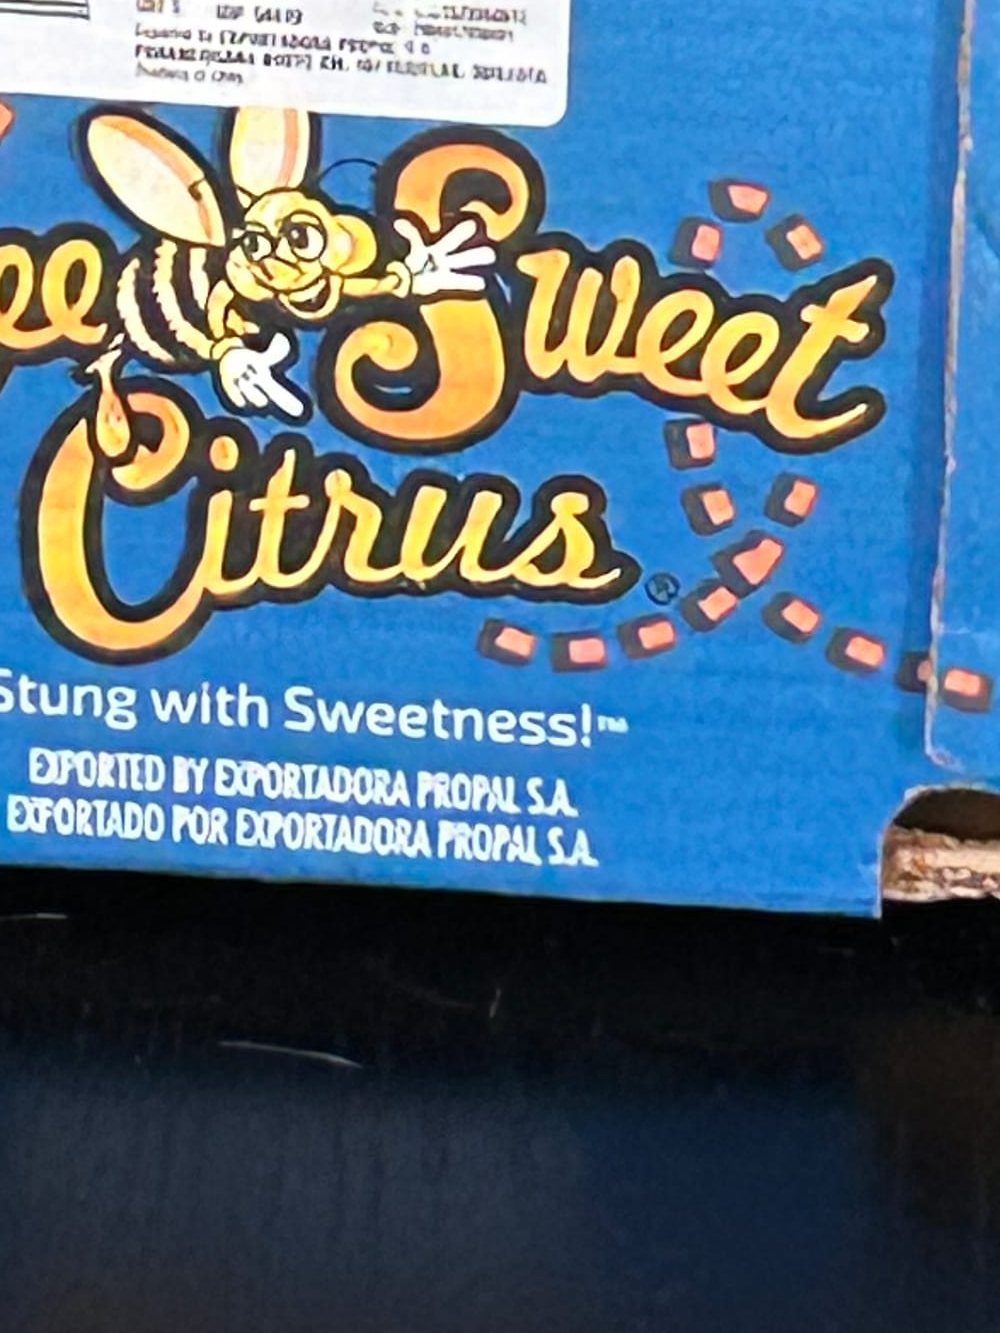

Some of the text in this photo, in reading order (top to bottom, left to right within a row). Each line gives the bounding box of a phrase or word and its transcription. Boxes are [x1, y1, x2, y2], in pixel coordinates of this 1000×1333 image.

[326, 134, 886, 447] Sweet
[30, 386, 630, 658] Citrus
[150, 680, 269, 730] with
[28, 746, 166, 792] EXPORTED
[172, 754, 210, 795] BY
[214, 757, 412, 809] EXPORTADORA
[416, 769, 522, 816] PROPAL
[6, 793, 165, 843] EXPORTADO
[171, 803, 229, 847] POR
[234, 806, 434, 860] EXPORTADORA
[436, 819, 543, 867] PROPAL
